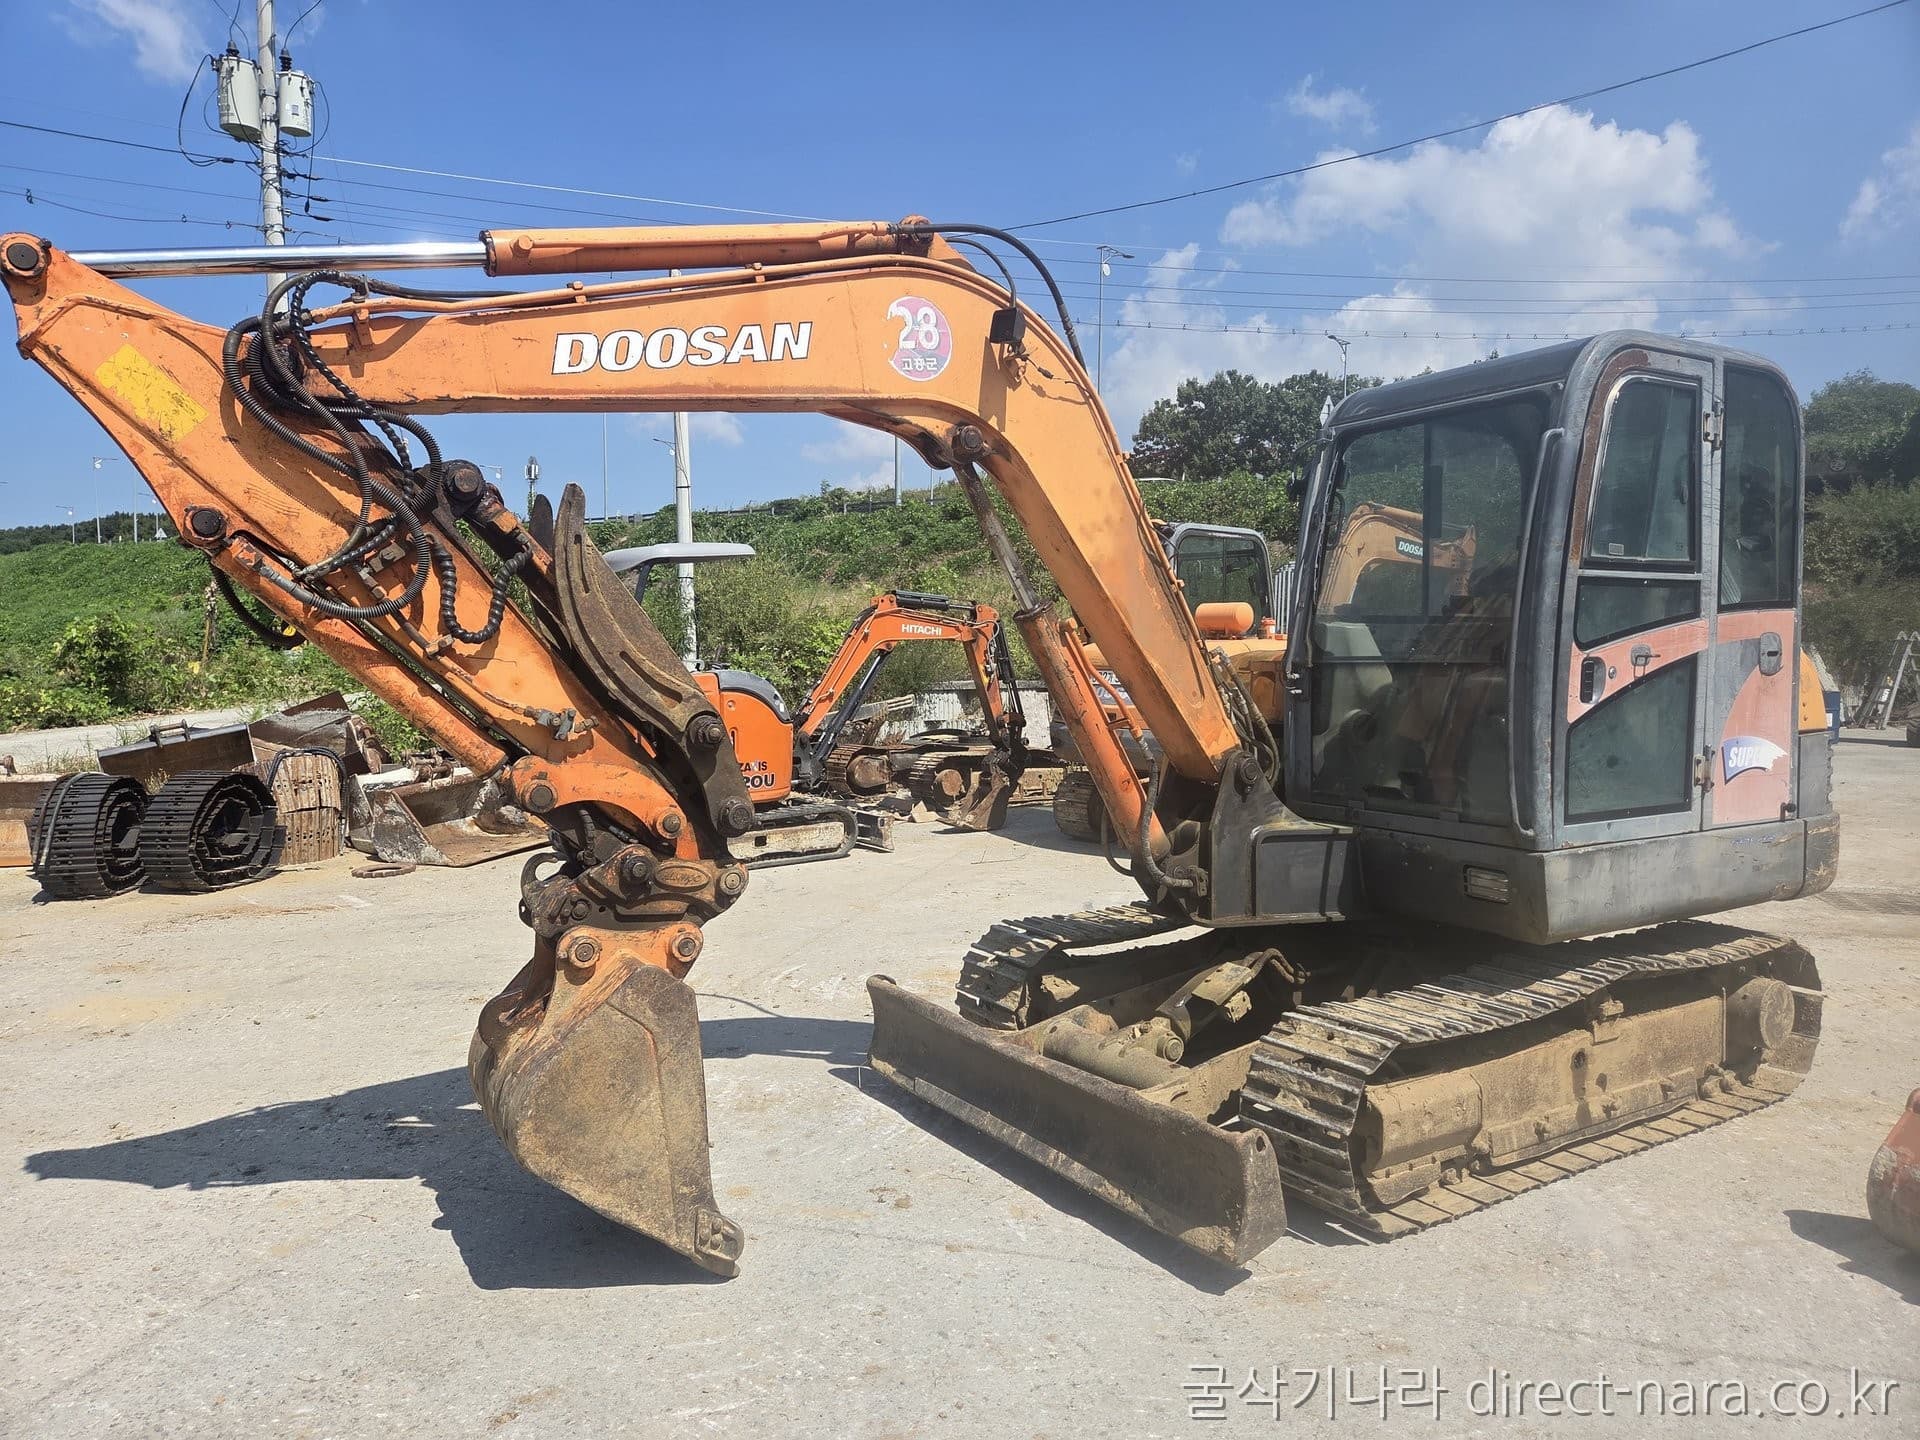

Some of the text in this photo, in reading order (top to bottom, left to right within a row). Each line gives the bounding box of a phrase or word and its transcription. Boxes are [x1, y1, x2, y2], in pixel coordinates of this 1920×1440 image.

[890, 306, 940, 350] 28
[551, 321, 813, 375] DOOSAN
[1398, 540, 1424, 557] DOOSA
[901, 623, 942, 636] HITACHI
